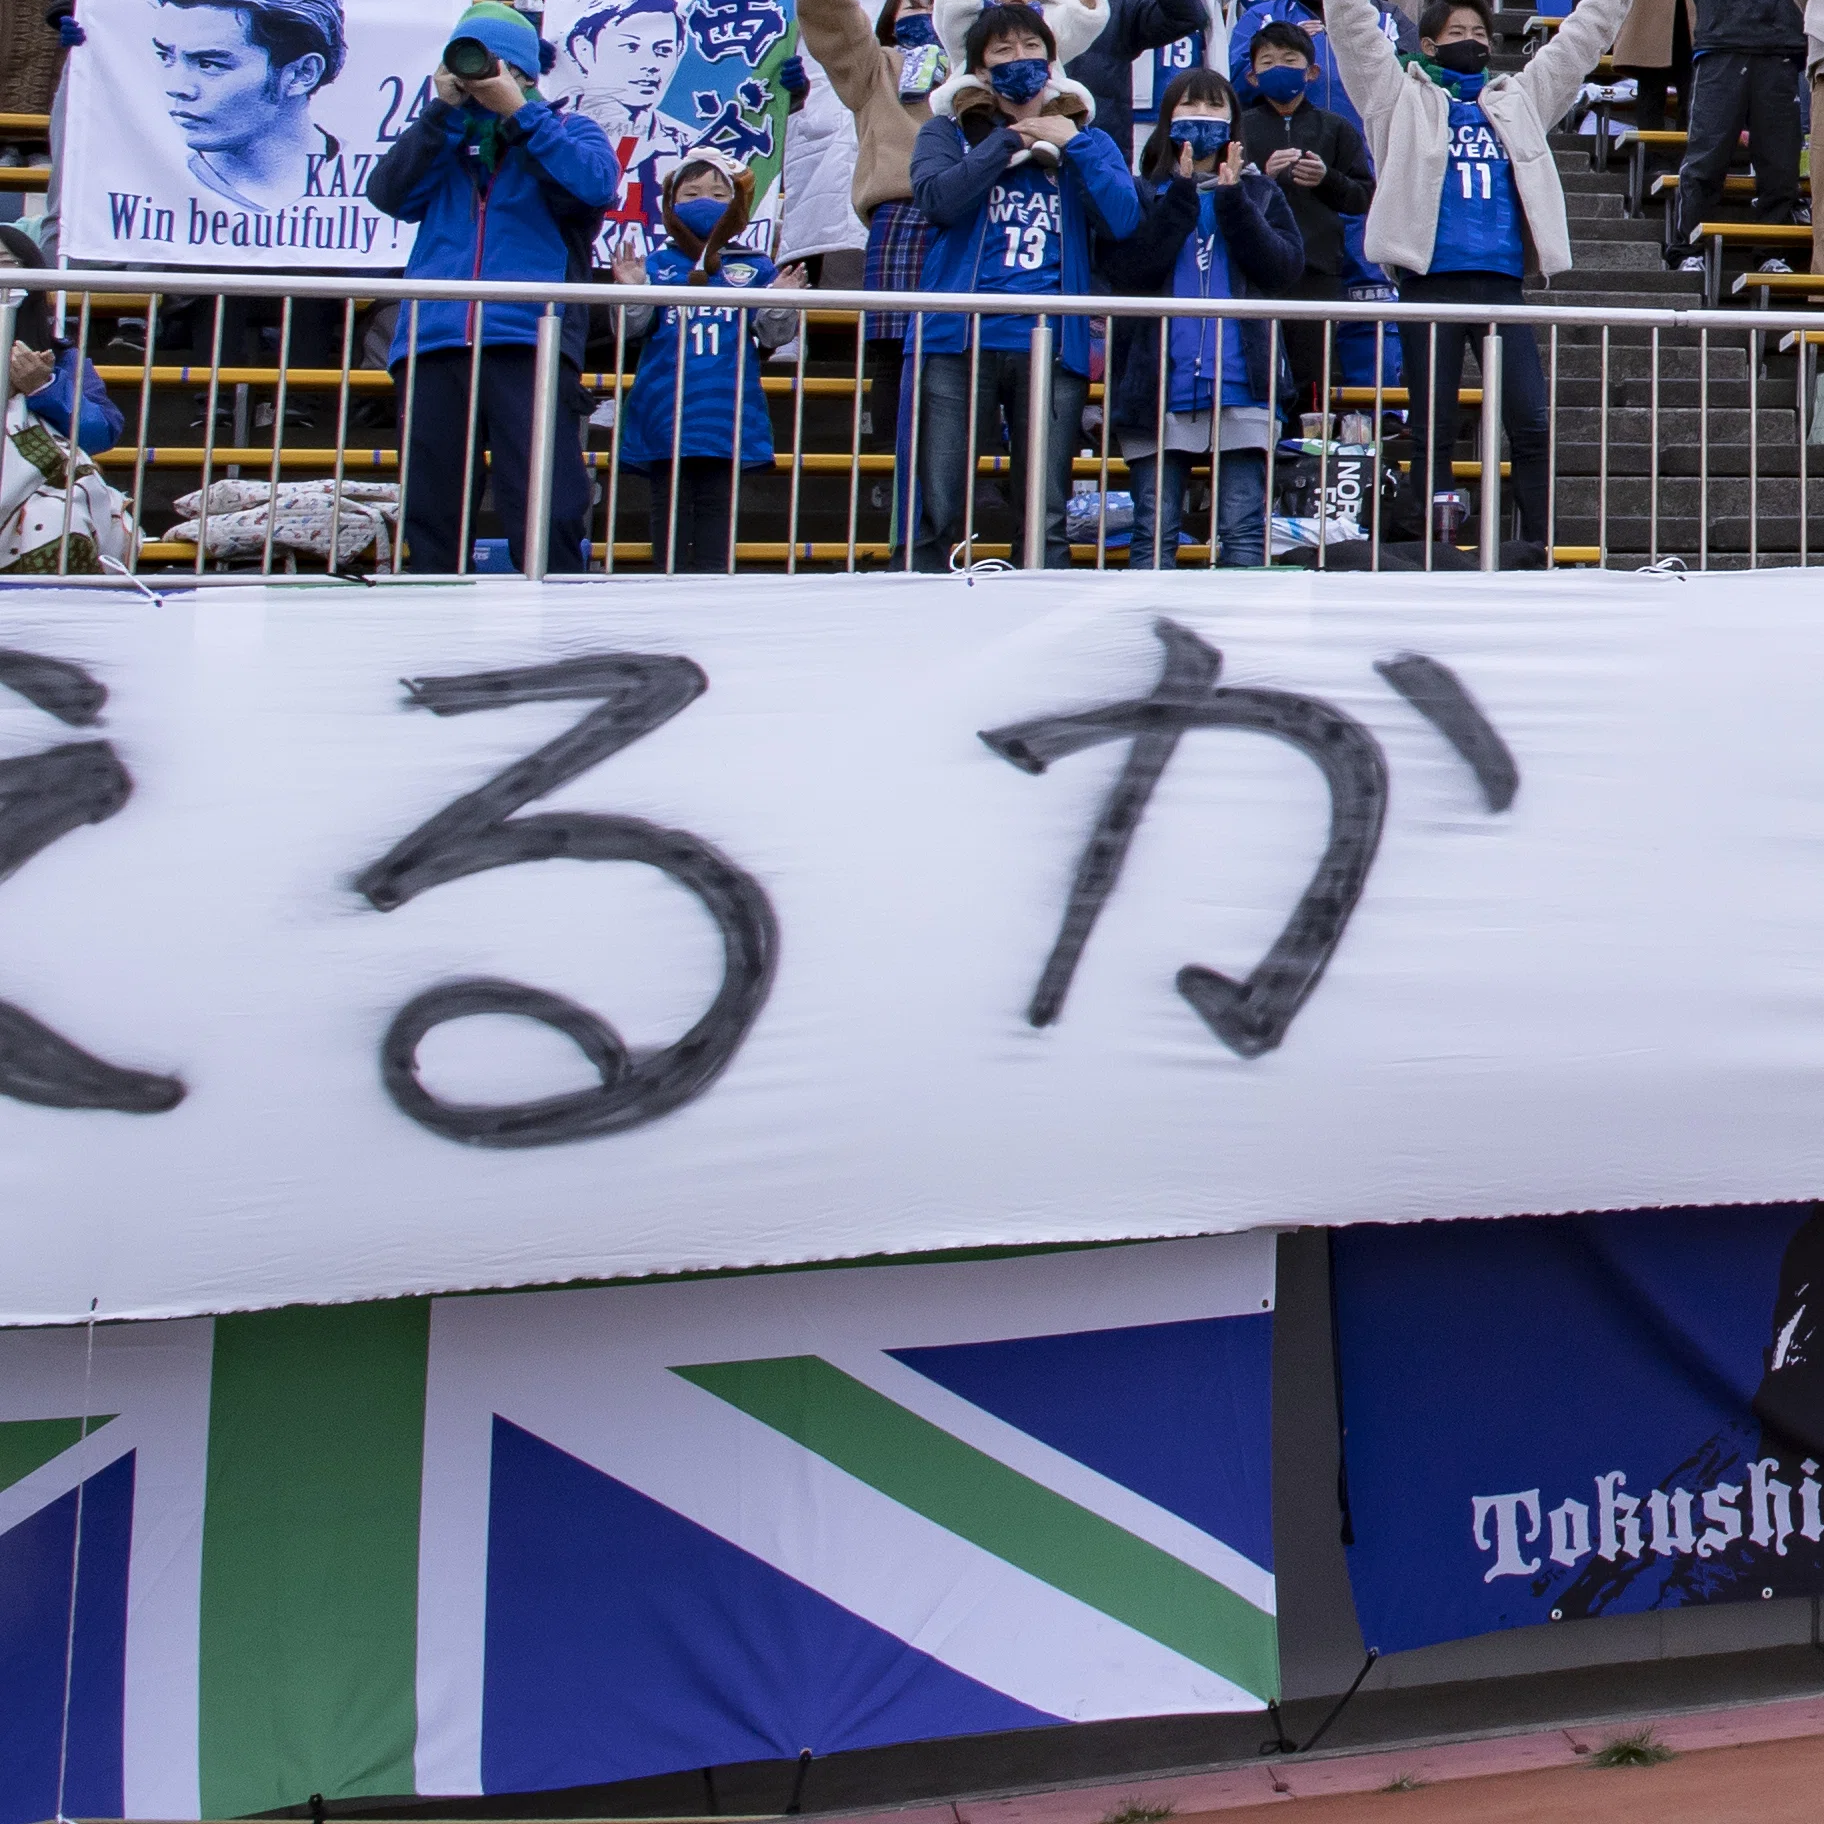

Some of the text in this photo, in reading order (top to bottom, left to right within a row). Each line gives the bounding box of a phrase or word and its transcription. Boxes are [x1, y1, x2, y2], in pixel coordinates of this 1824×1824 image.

[1160, 36, 1193, 69] 13
[304, 153, 369, 199] KAZ
[1456, 162, 1492, 200] 11
[989, 185, 1062, 213] OCAR
[109, 192, 174, 242] Win
[187, 196, 381, 255] beautifully
[988, 204, 1063, 234] WEAT
[1003, 226, 1048, 270] 13
[691, 323, 720, 356] 11
[1313, 487, 1338, 520] FA
[1336, 461, 1362, 522] NOR
